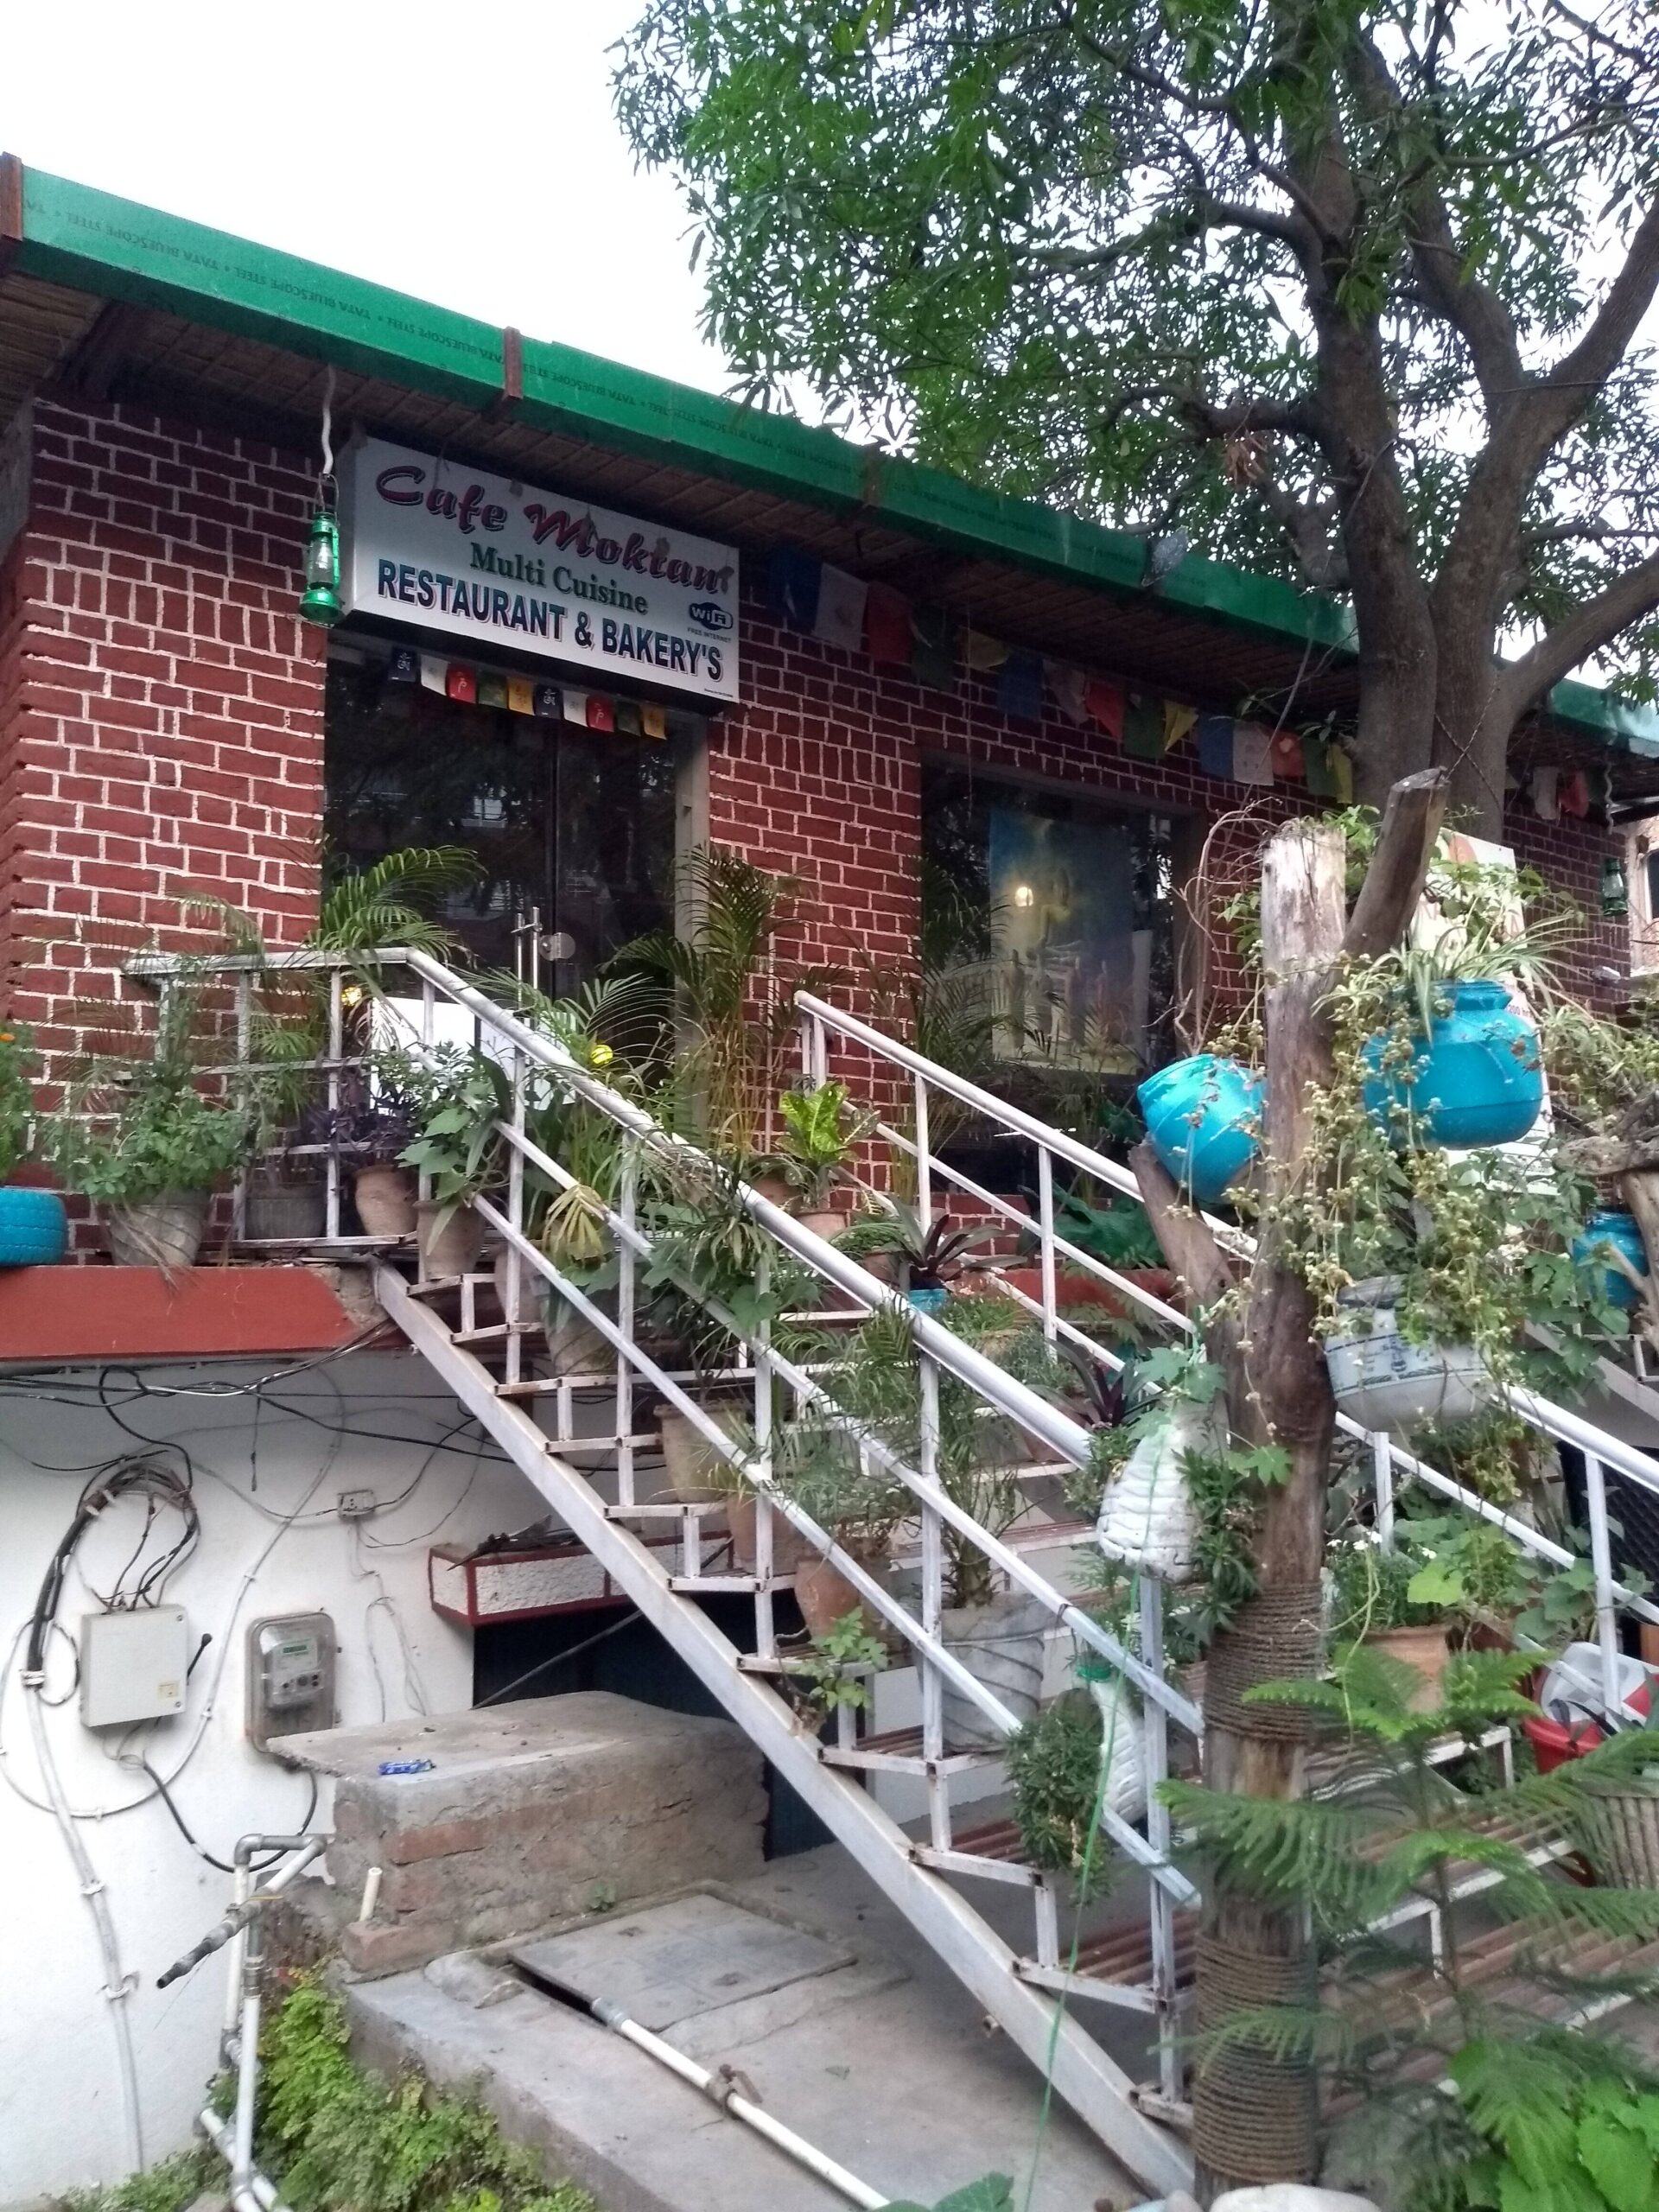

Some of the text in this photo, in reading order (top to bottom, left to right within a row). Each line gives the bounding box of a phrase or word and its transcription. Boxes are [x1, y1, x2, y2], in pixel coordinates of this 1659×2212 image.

[106, 227, 179, 257] BLUESCOPE
[183, 251, 217, 270] TATA
[233, 267, 265, 285] STEEL
[270, 280, 335, 308] BLUESCOPE
[338, 302, 370, 319] TATA
[386, 317, 415, 334] STEEL
[417, 328, 477, 355] BLUESCOPE
[607, 389, 636, 405] TATA
[376, 465, 507, 534] Cafe
[470, 542, 648, 615] Multi Cuisine
[378, 558, 723, 683] RESTAURANT & BAKERY'S
